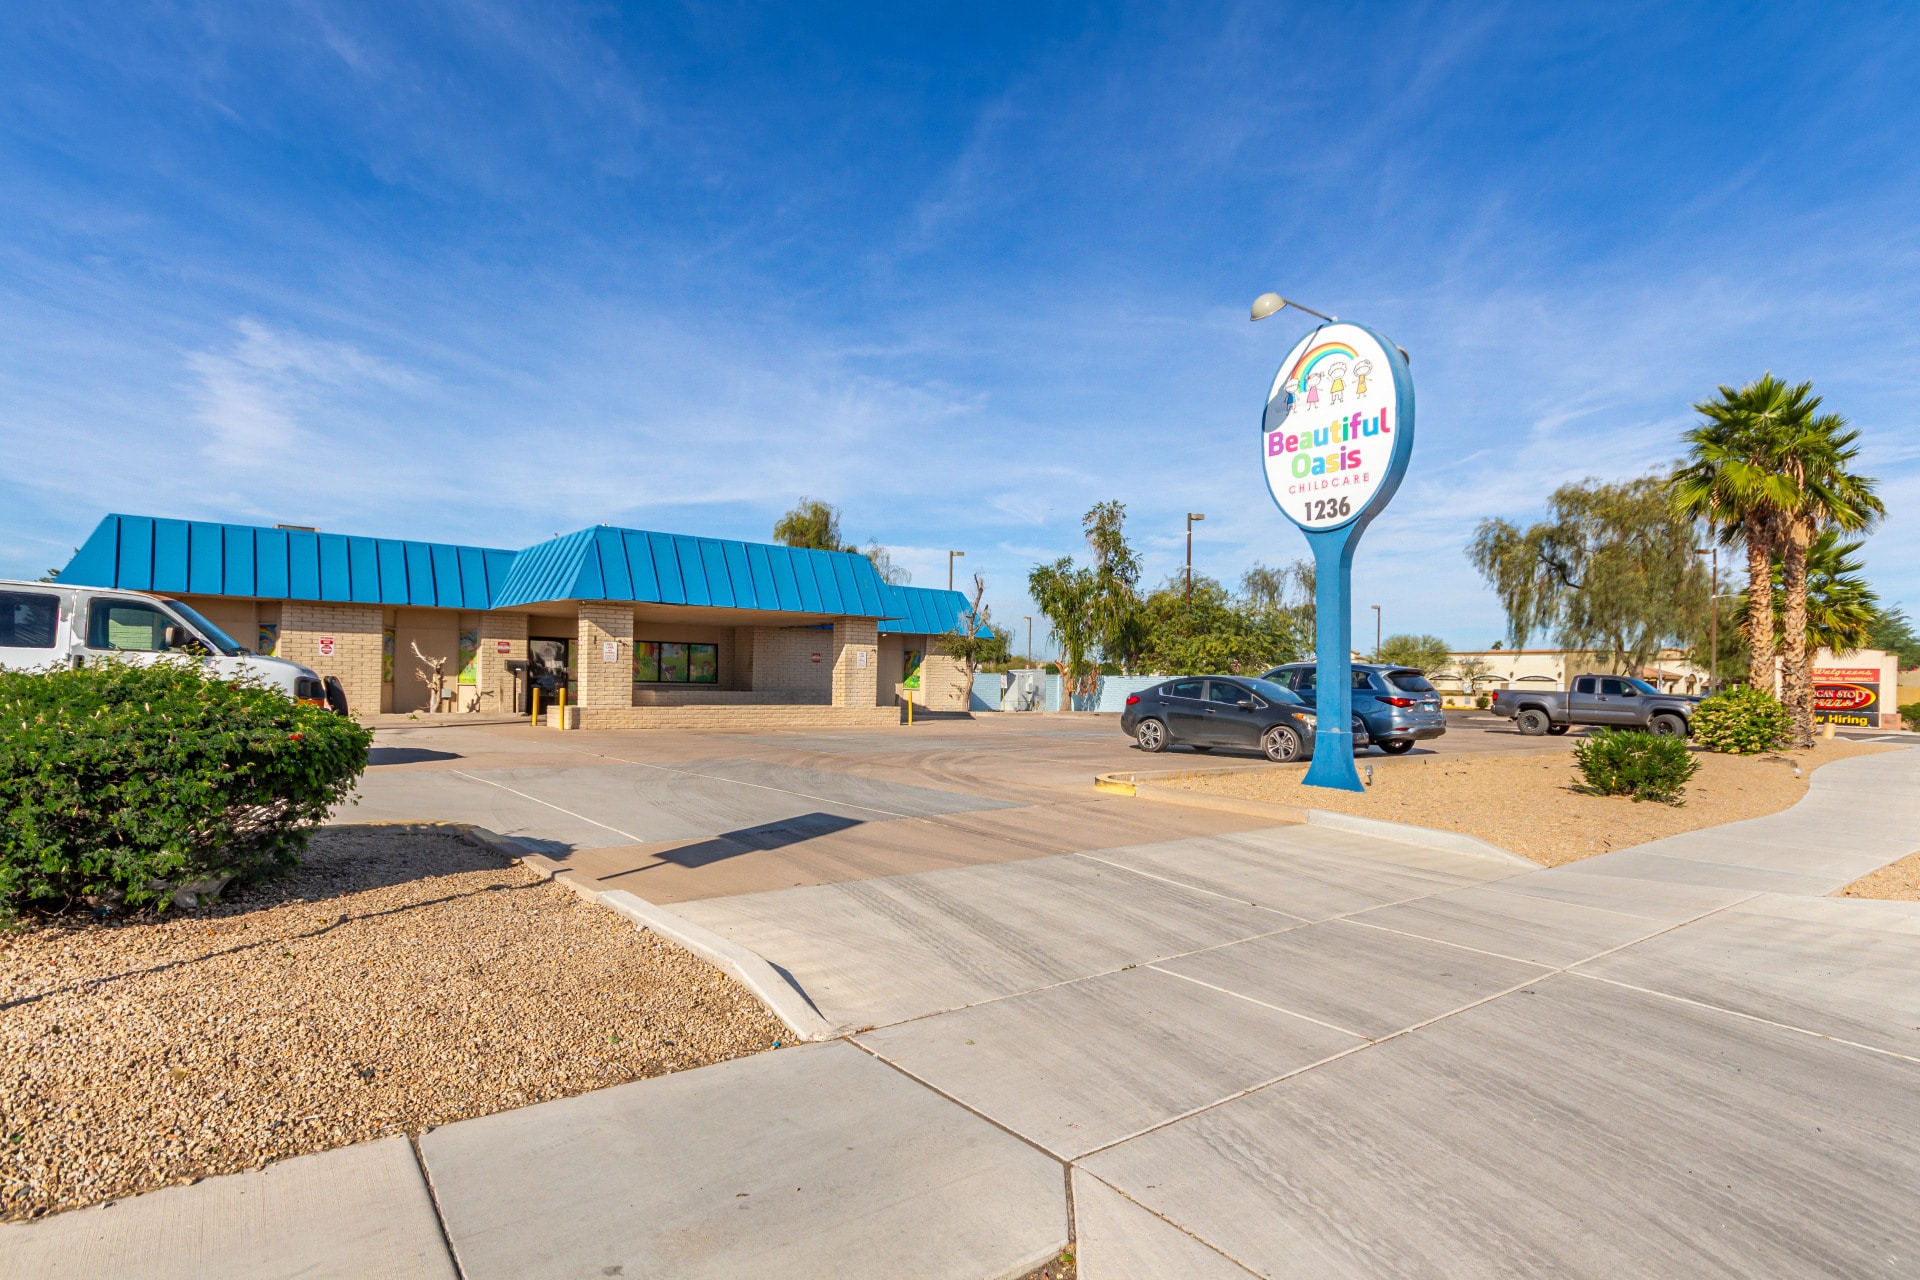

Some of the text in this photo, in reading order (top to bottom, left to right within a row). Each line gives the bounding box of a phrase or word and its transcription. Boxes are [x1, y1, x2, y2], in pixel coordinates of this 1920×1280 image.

[1268, 406, 1391, 457] Beautiful
[1291, 445, 1362, 479] Oasis
[1288, 472, 1371, 495] CHILDCARE
[1304, 495, 1351, 522] 1236
[1813, 668, 1873, 677] Walgreens
[1828, 714, 1868, 726] Hiring
